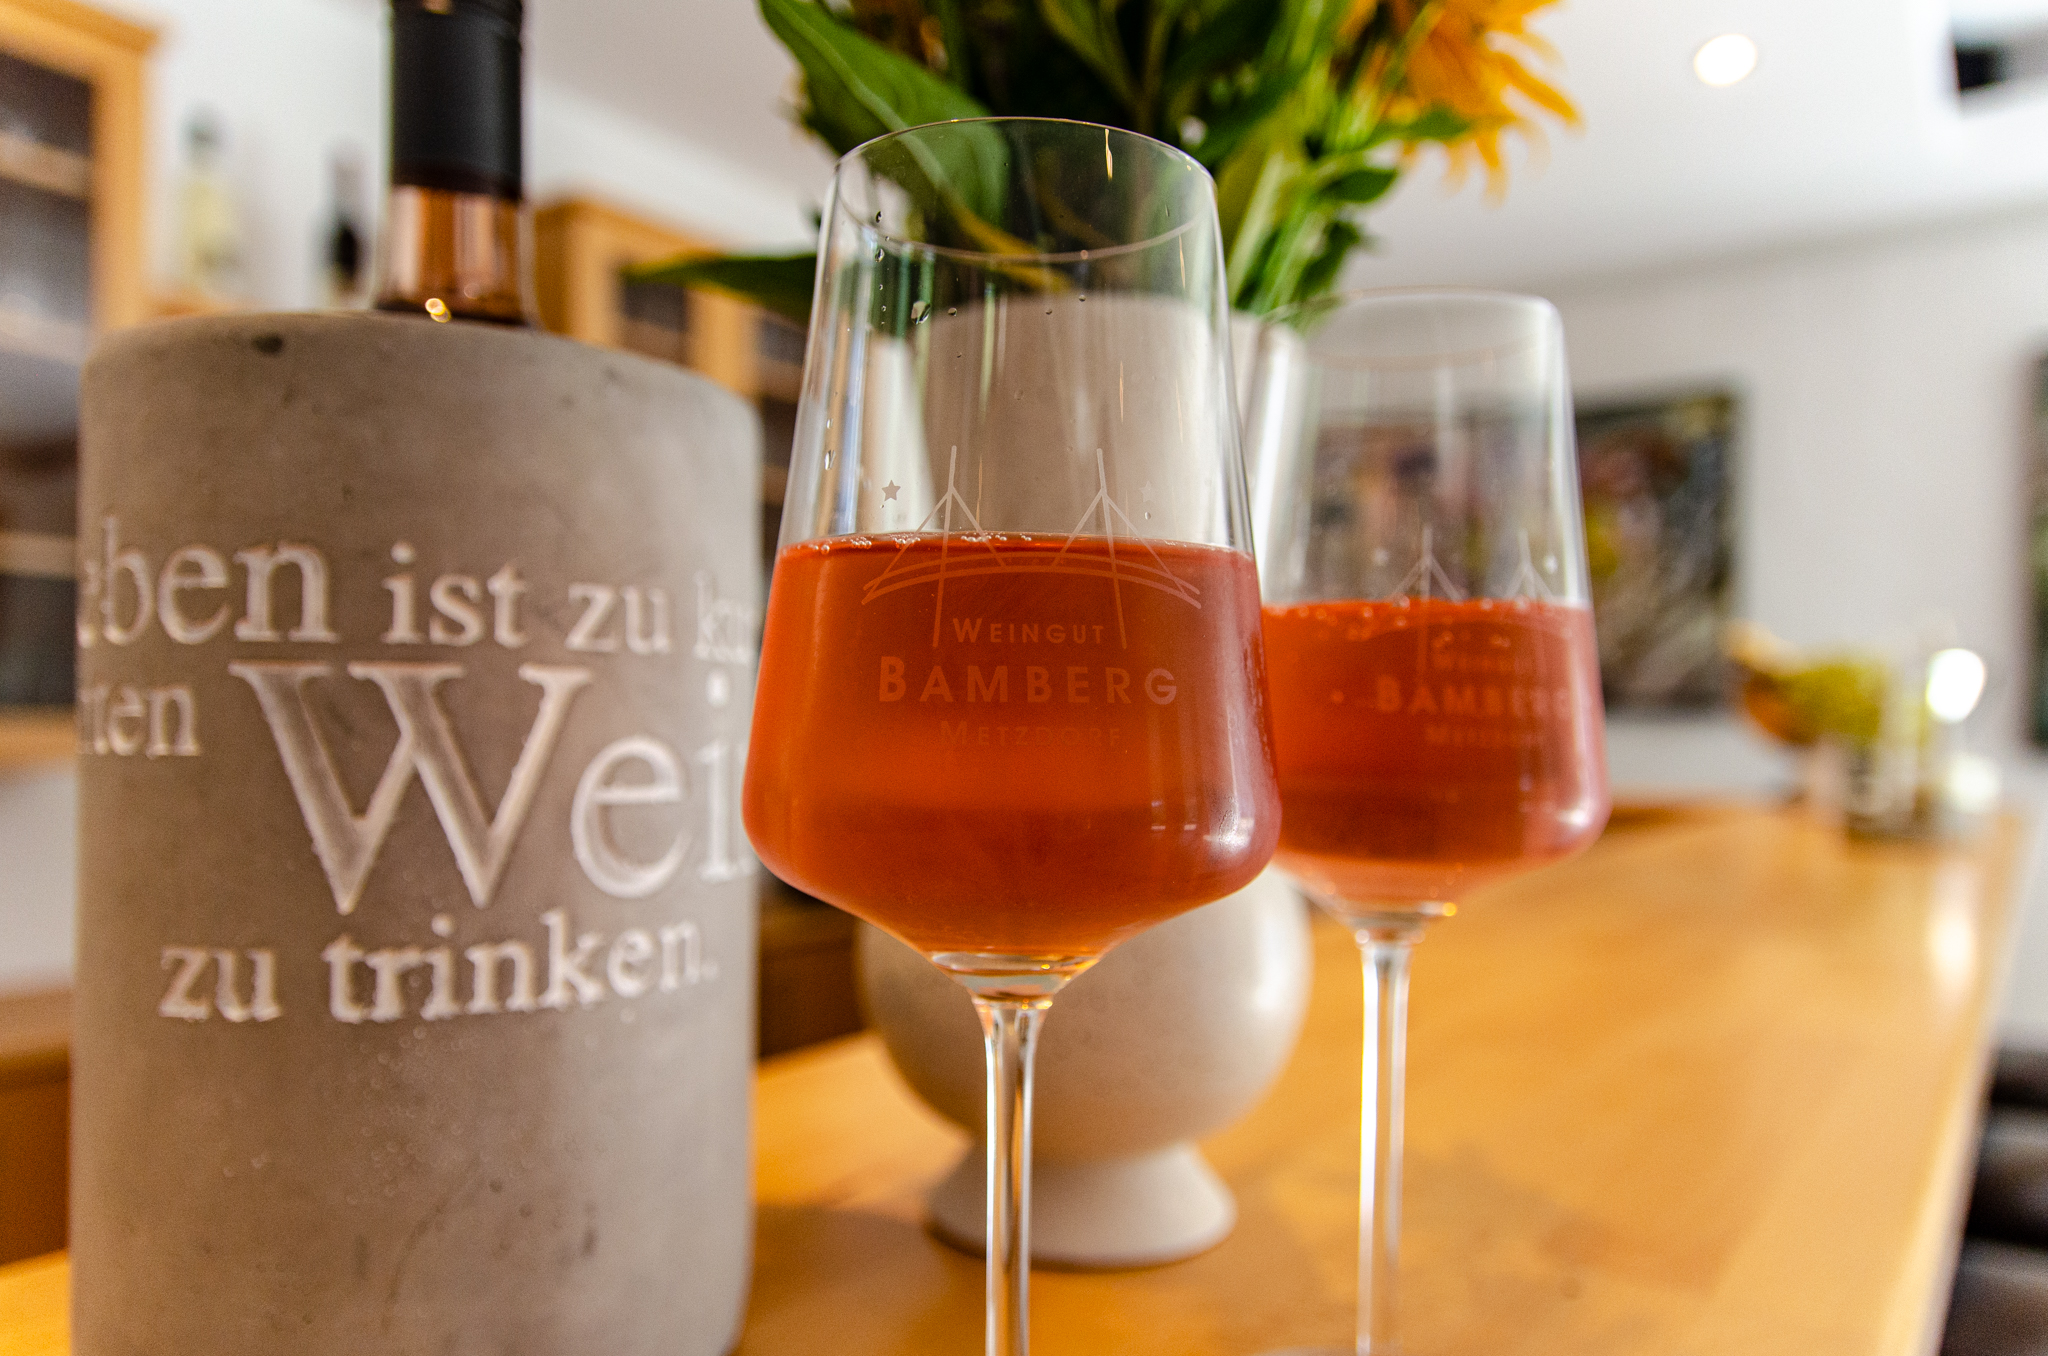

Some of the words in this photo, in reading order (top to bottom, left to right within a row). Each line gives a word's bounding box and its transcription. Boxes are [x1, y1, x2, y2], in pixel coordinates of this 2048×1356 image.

[381, 540, 533, 648] ist
[564, 579, 672, 655] zu
[951, 617, 1105, 645] WEINGUT
[878, 655, 1178, 706] BAMBERG
[939, 720, 1122, 748] METZDORF
[227, 660, 754, 916] Wei
[158, 943, 284, 1023] zu
[321, 907, 719, 1024] trinken.
